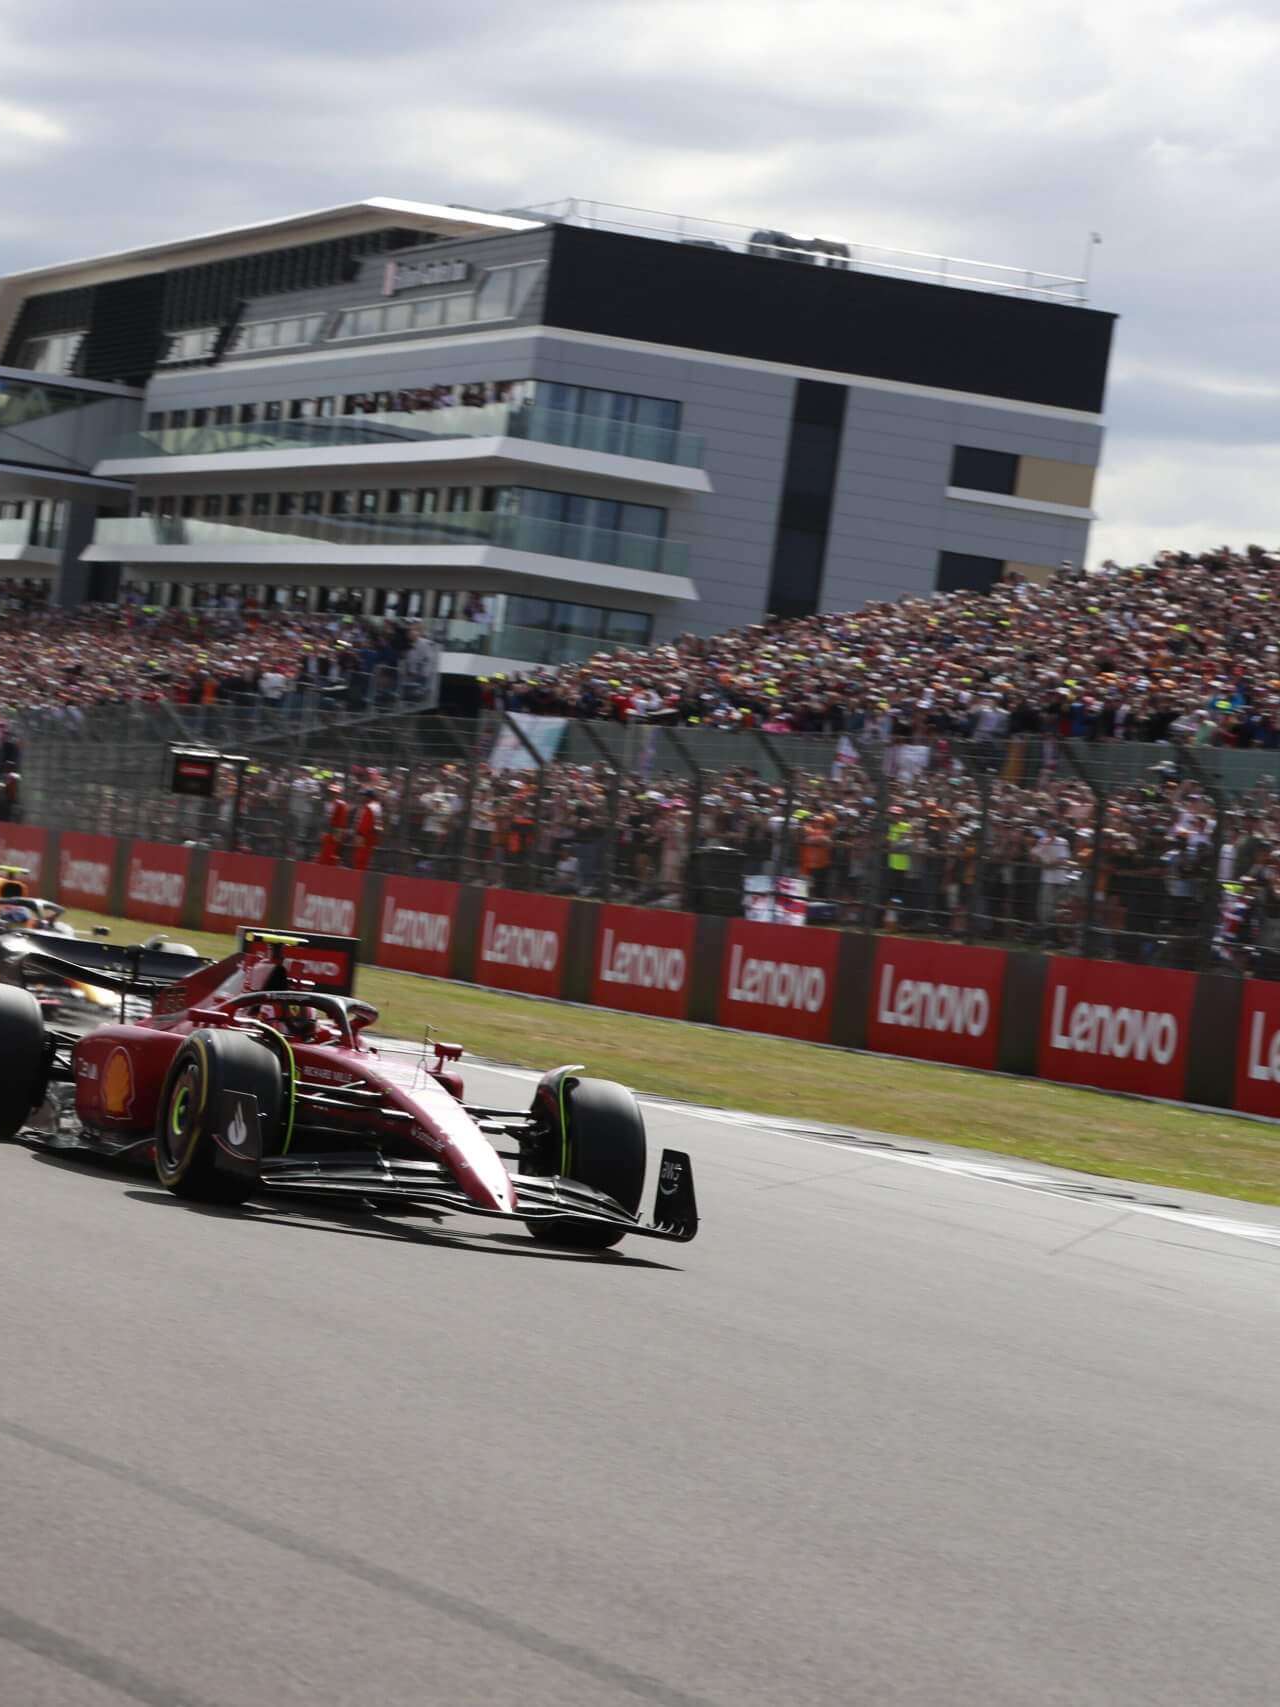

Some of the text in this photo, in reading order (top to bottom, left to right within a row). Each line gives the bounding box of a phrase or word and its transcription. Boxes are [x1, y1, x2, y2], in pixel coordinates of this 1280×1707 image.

[381, 896, 450, 952] Lenovo
[481, 911, 559, 971] Lenovo
[600, 928, 686, 991] Lenovo
[728, 944, 825, 1012] Lenovo
[878, 964, 989, 1037] Lenovo
[1051, 985, 1177, 1065] Lenovo
